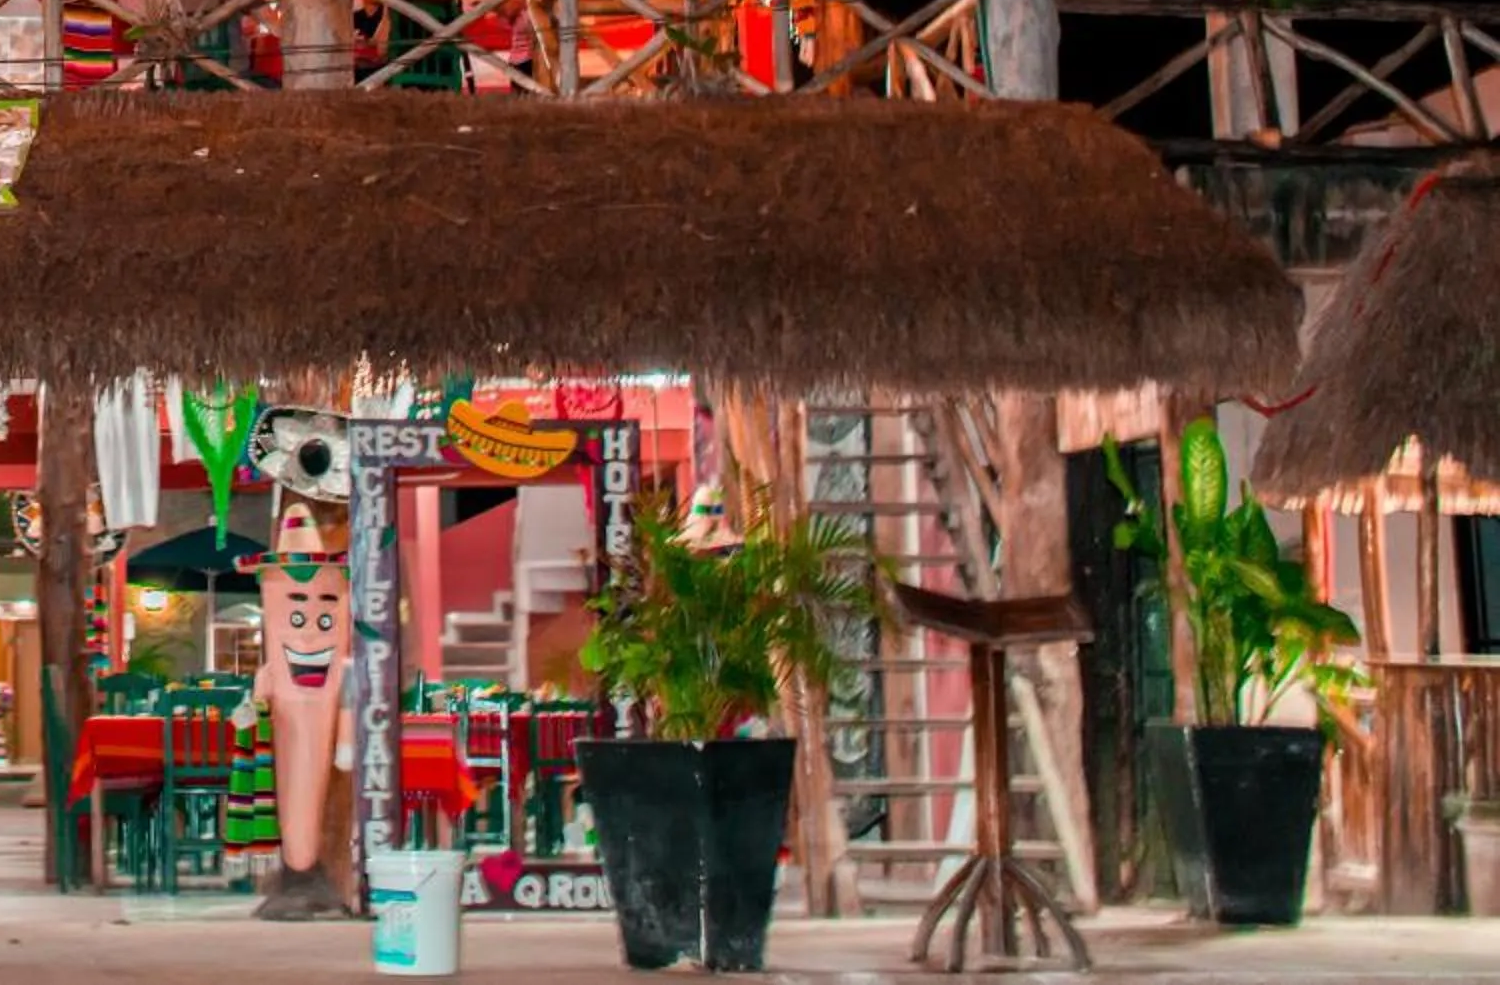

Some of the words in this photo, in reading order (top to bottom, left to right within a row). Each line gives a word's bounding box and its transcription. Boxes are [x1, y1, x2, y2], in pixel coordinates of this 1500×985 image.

[351, 426, 446, 461] REST
[357, 467, 392, 623] CHILE
[360, 639, 393, 856] PICANTE
